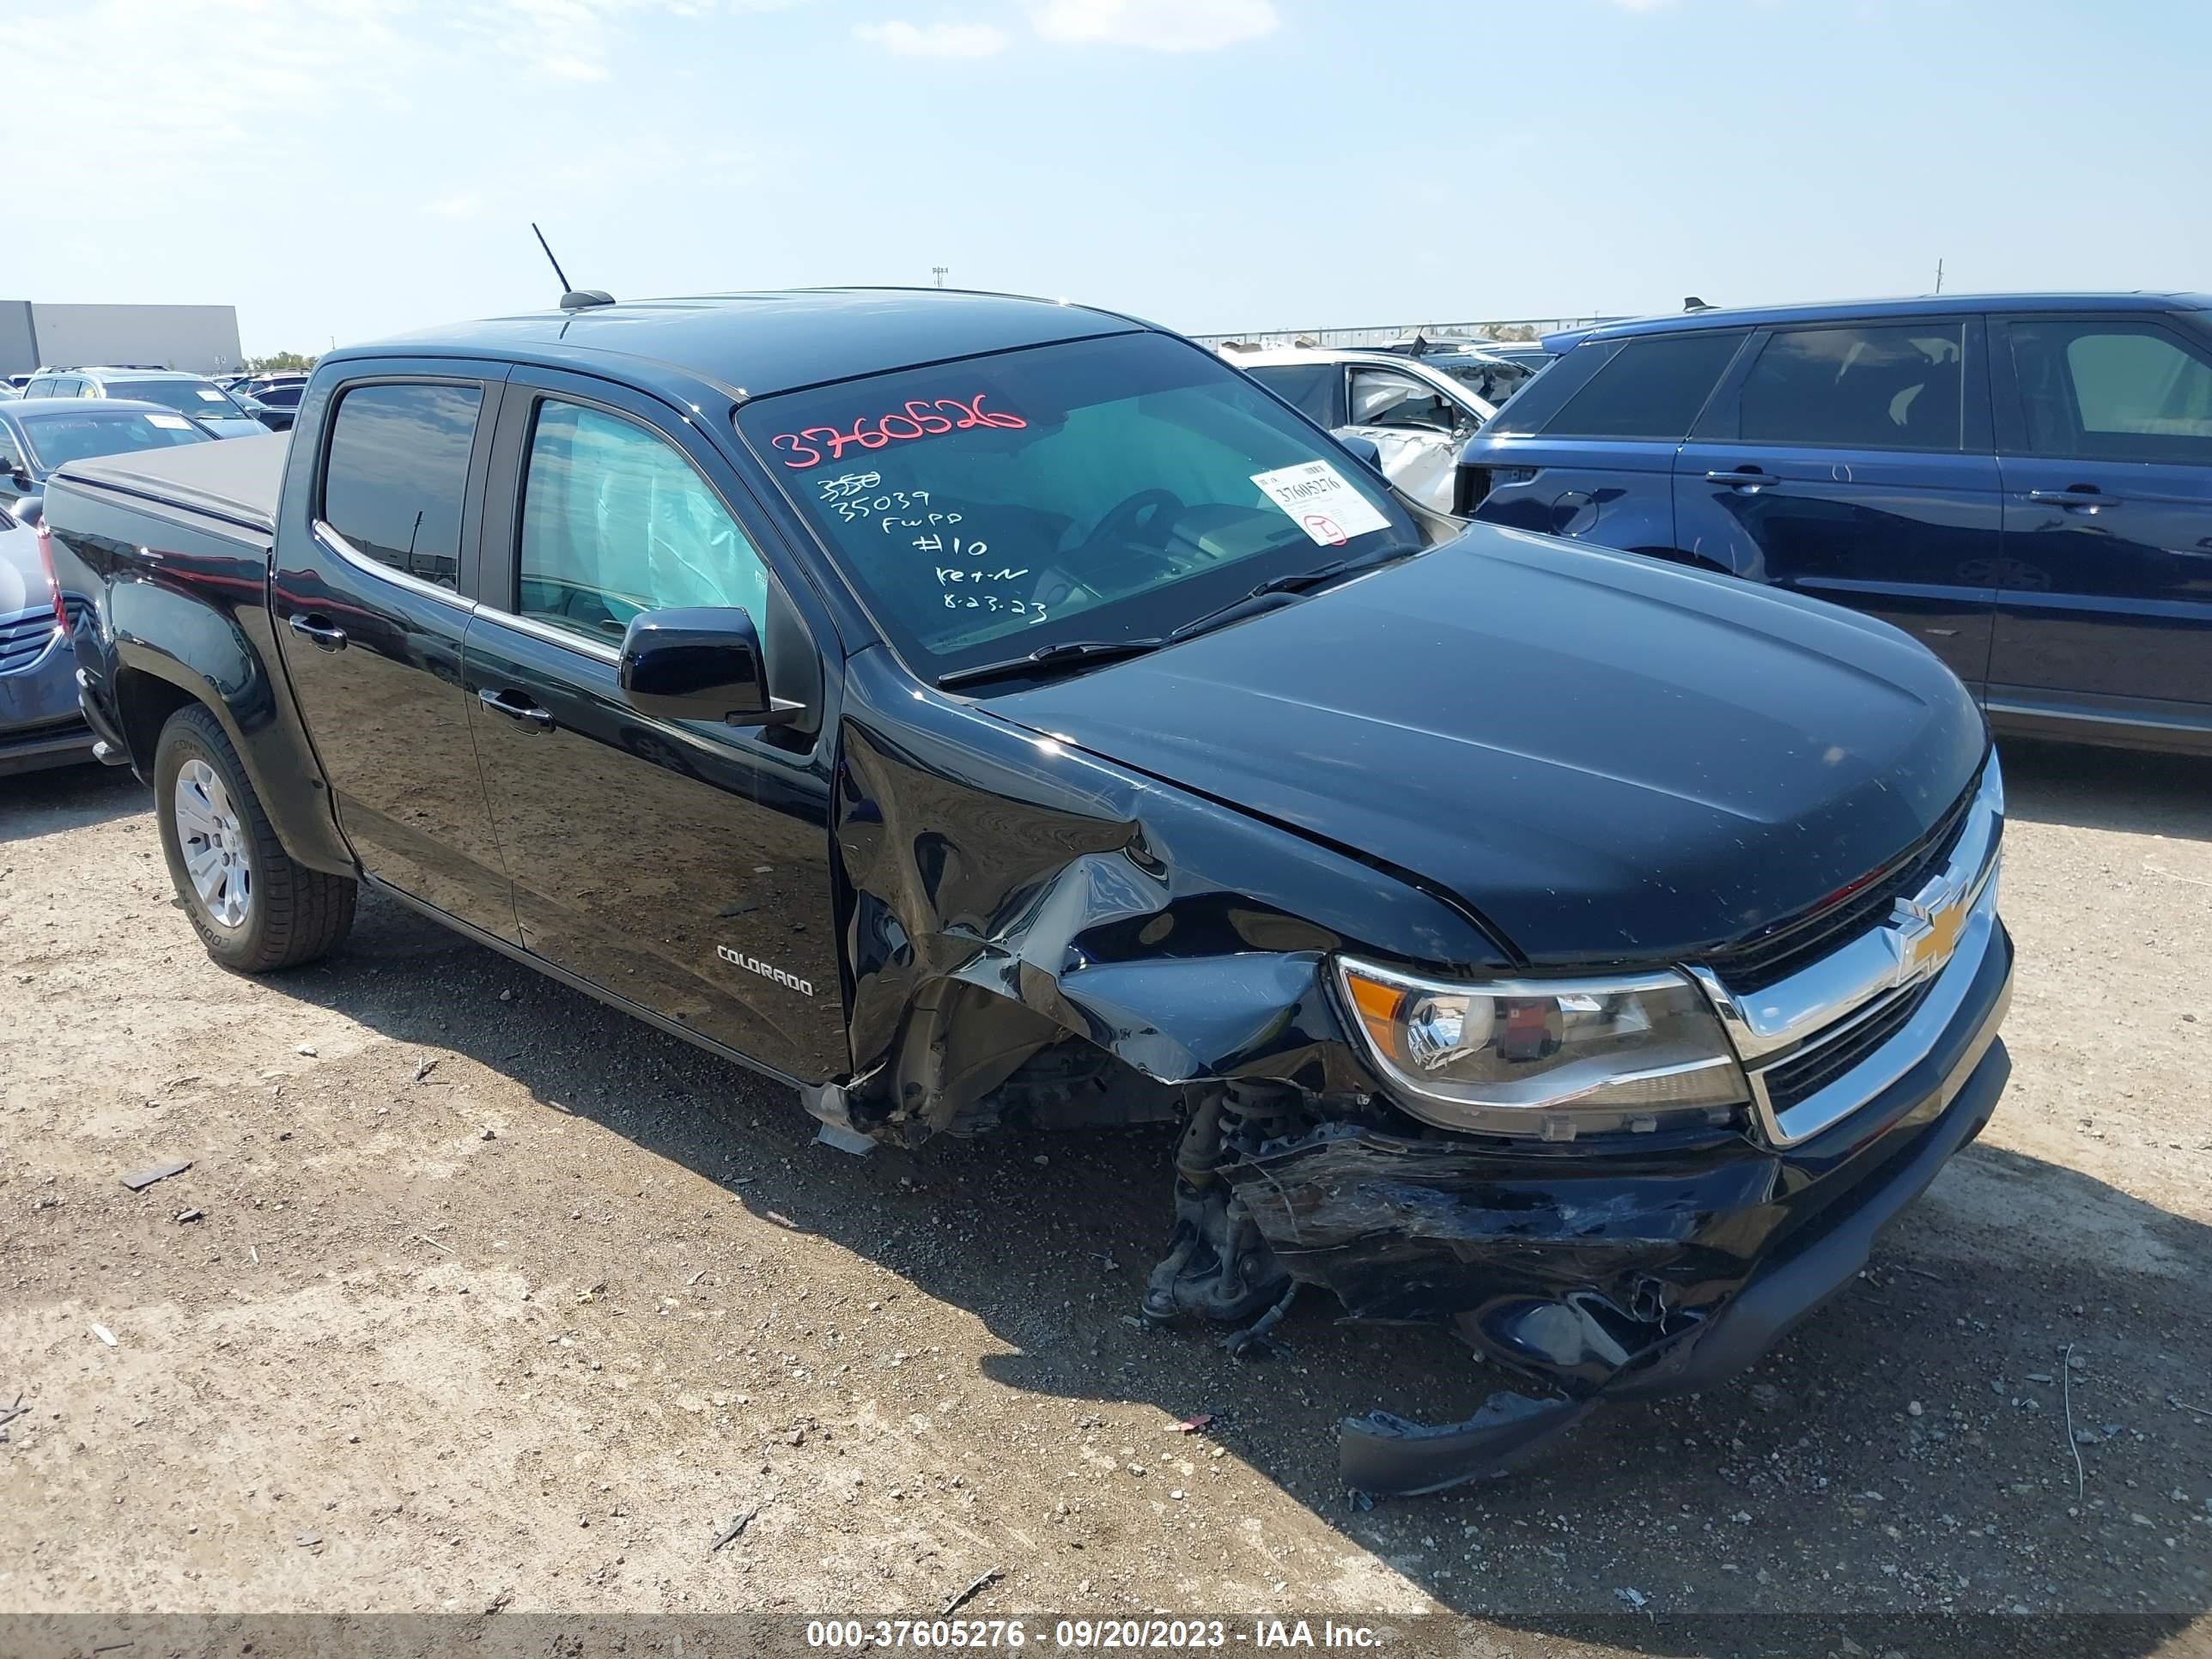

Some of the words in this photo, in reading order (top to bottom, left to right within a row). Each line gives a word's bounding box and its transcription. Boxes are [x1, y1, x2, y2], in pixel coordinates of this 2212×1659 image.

[772, 394, 1027, 468] 3760526
[830, 490, 929, 523] 35039
[1276, 476, 1340, 502] 37605276
[717, 945, 813, 997] COLORADO
